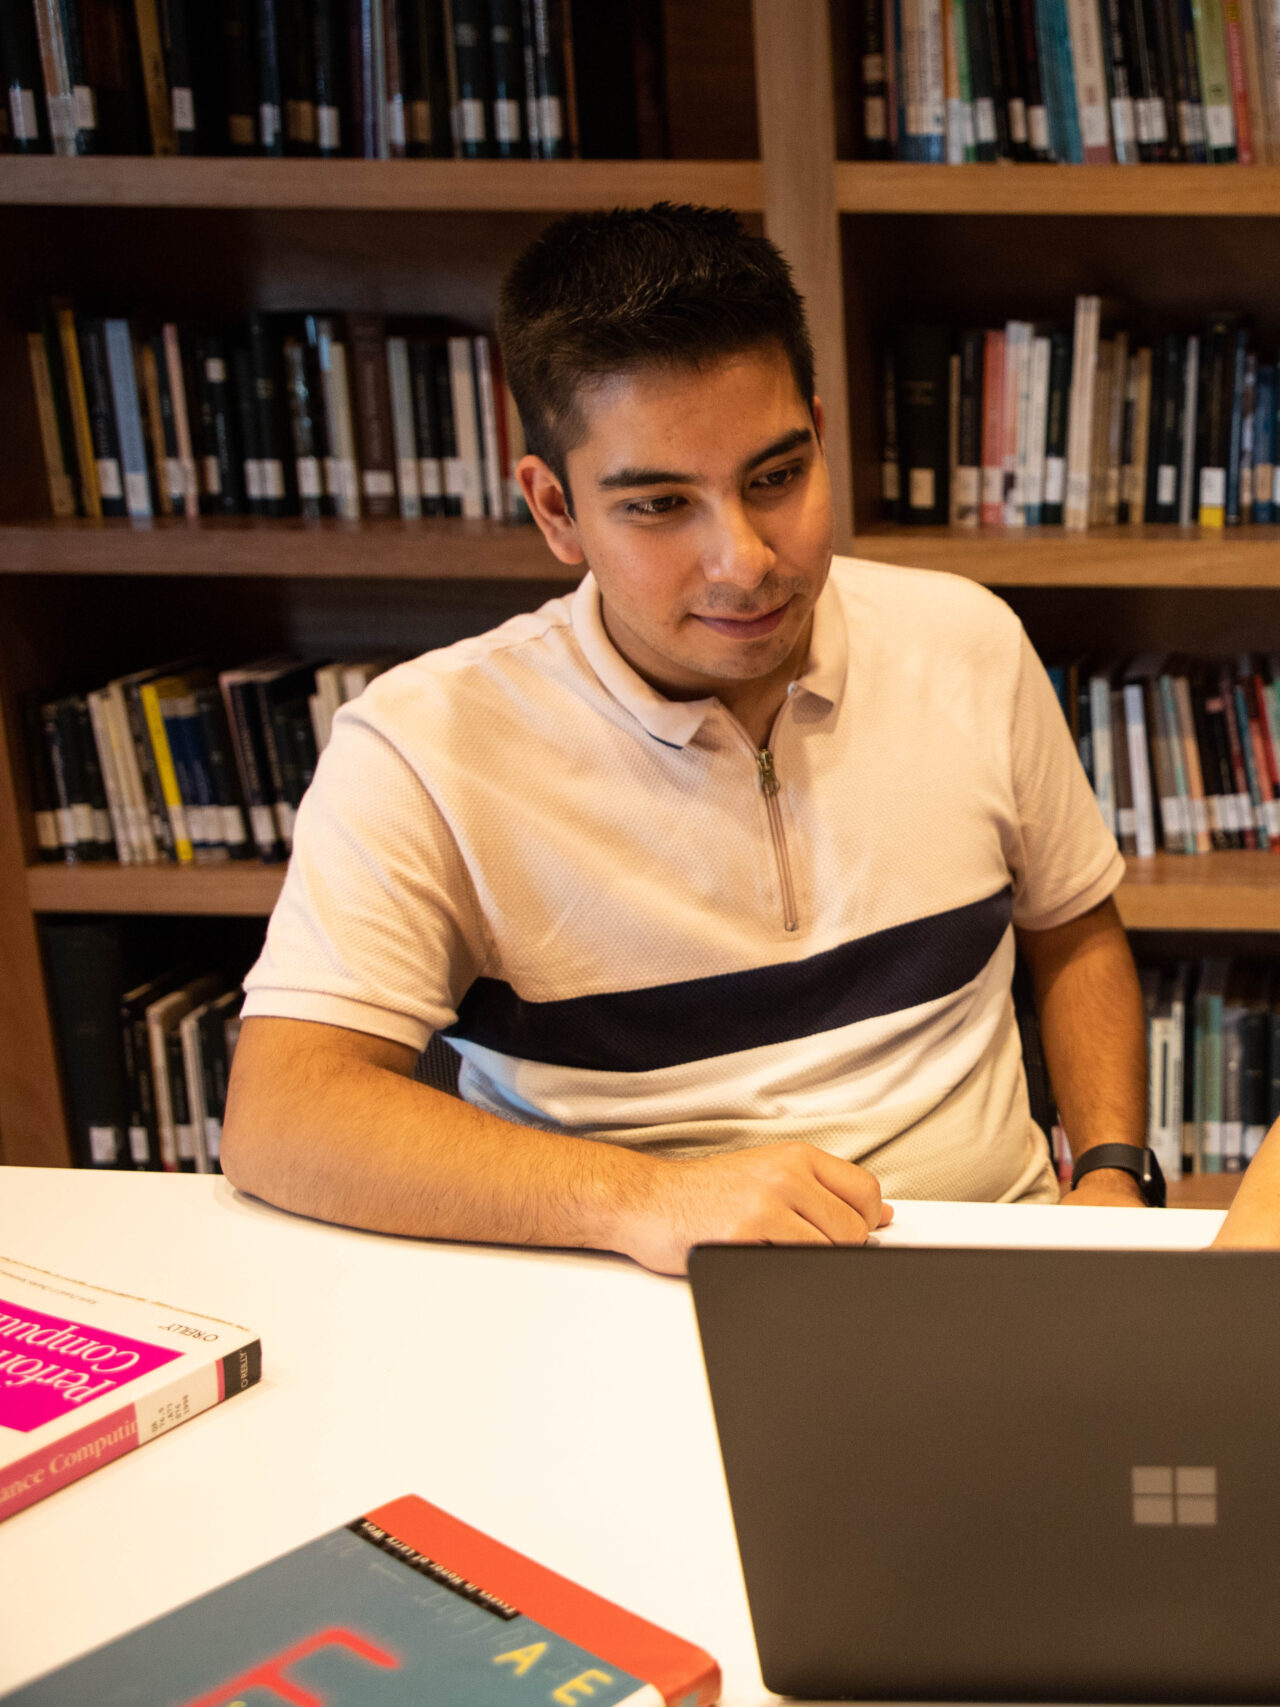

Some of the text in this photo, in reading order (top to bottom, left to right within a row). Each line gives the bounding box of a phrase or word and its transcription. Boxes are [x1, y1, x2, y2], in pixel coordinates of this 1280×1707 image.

[360, 1521, 386, 1540] Wos
[385, 1535, 416, 1556] Larry
[412, 1553, 430, 1565] of
[429, 1562, 465, 1585] Honor
[465, 1582, 479, 1592] in
